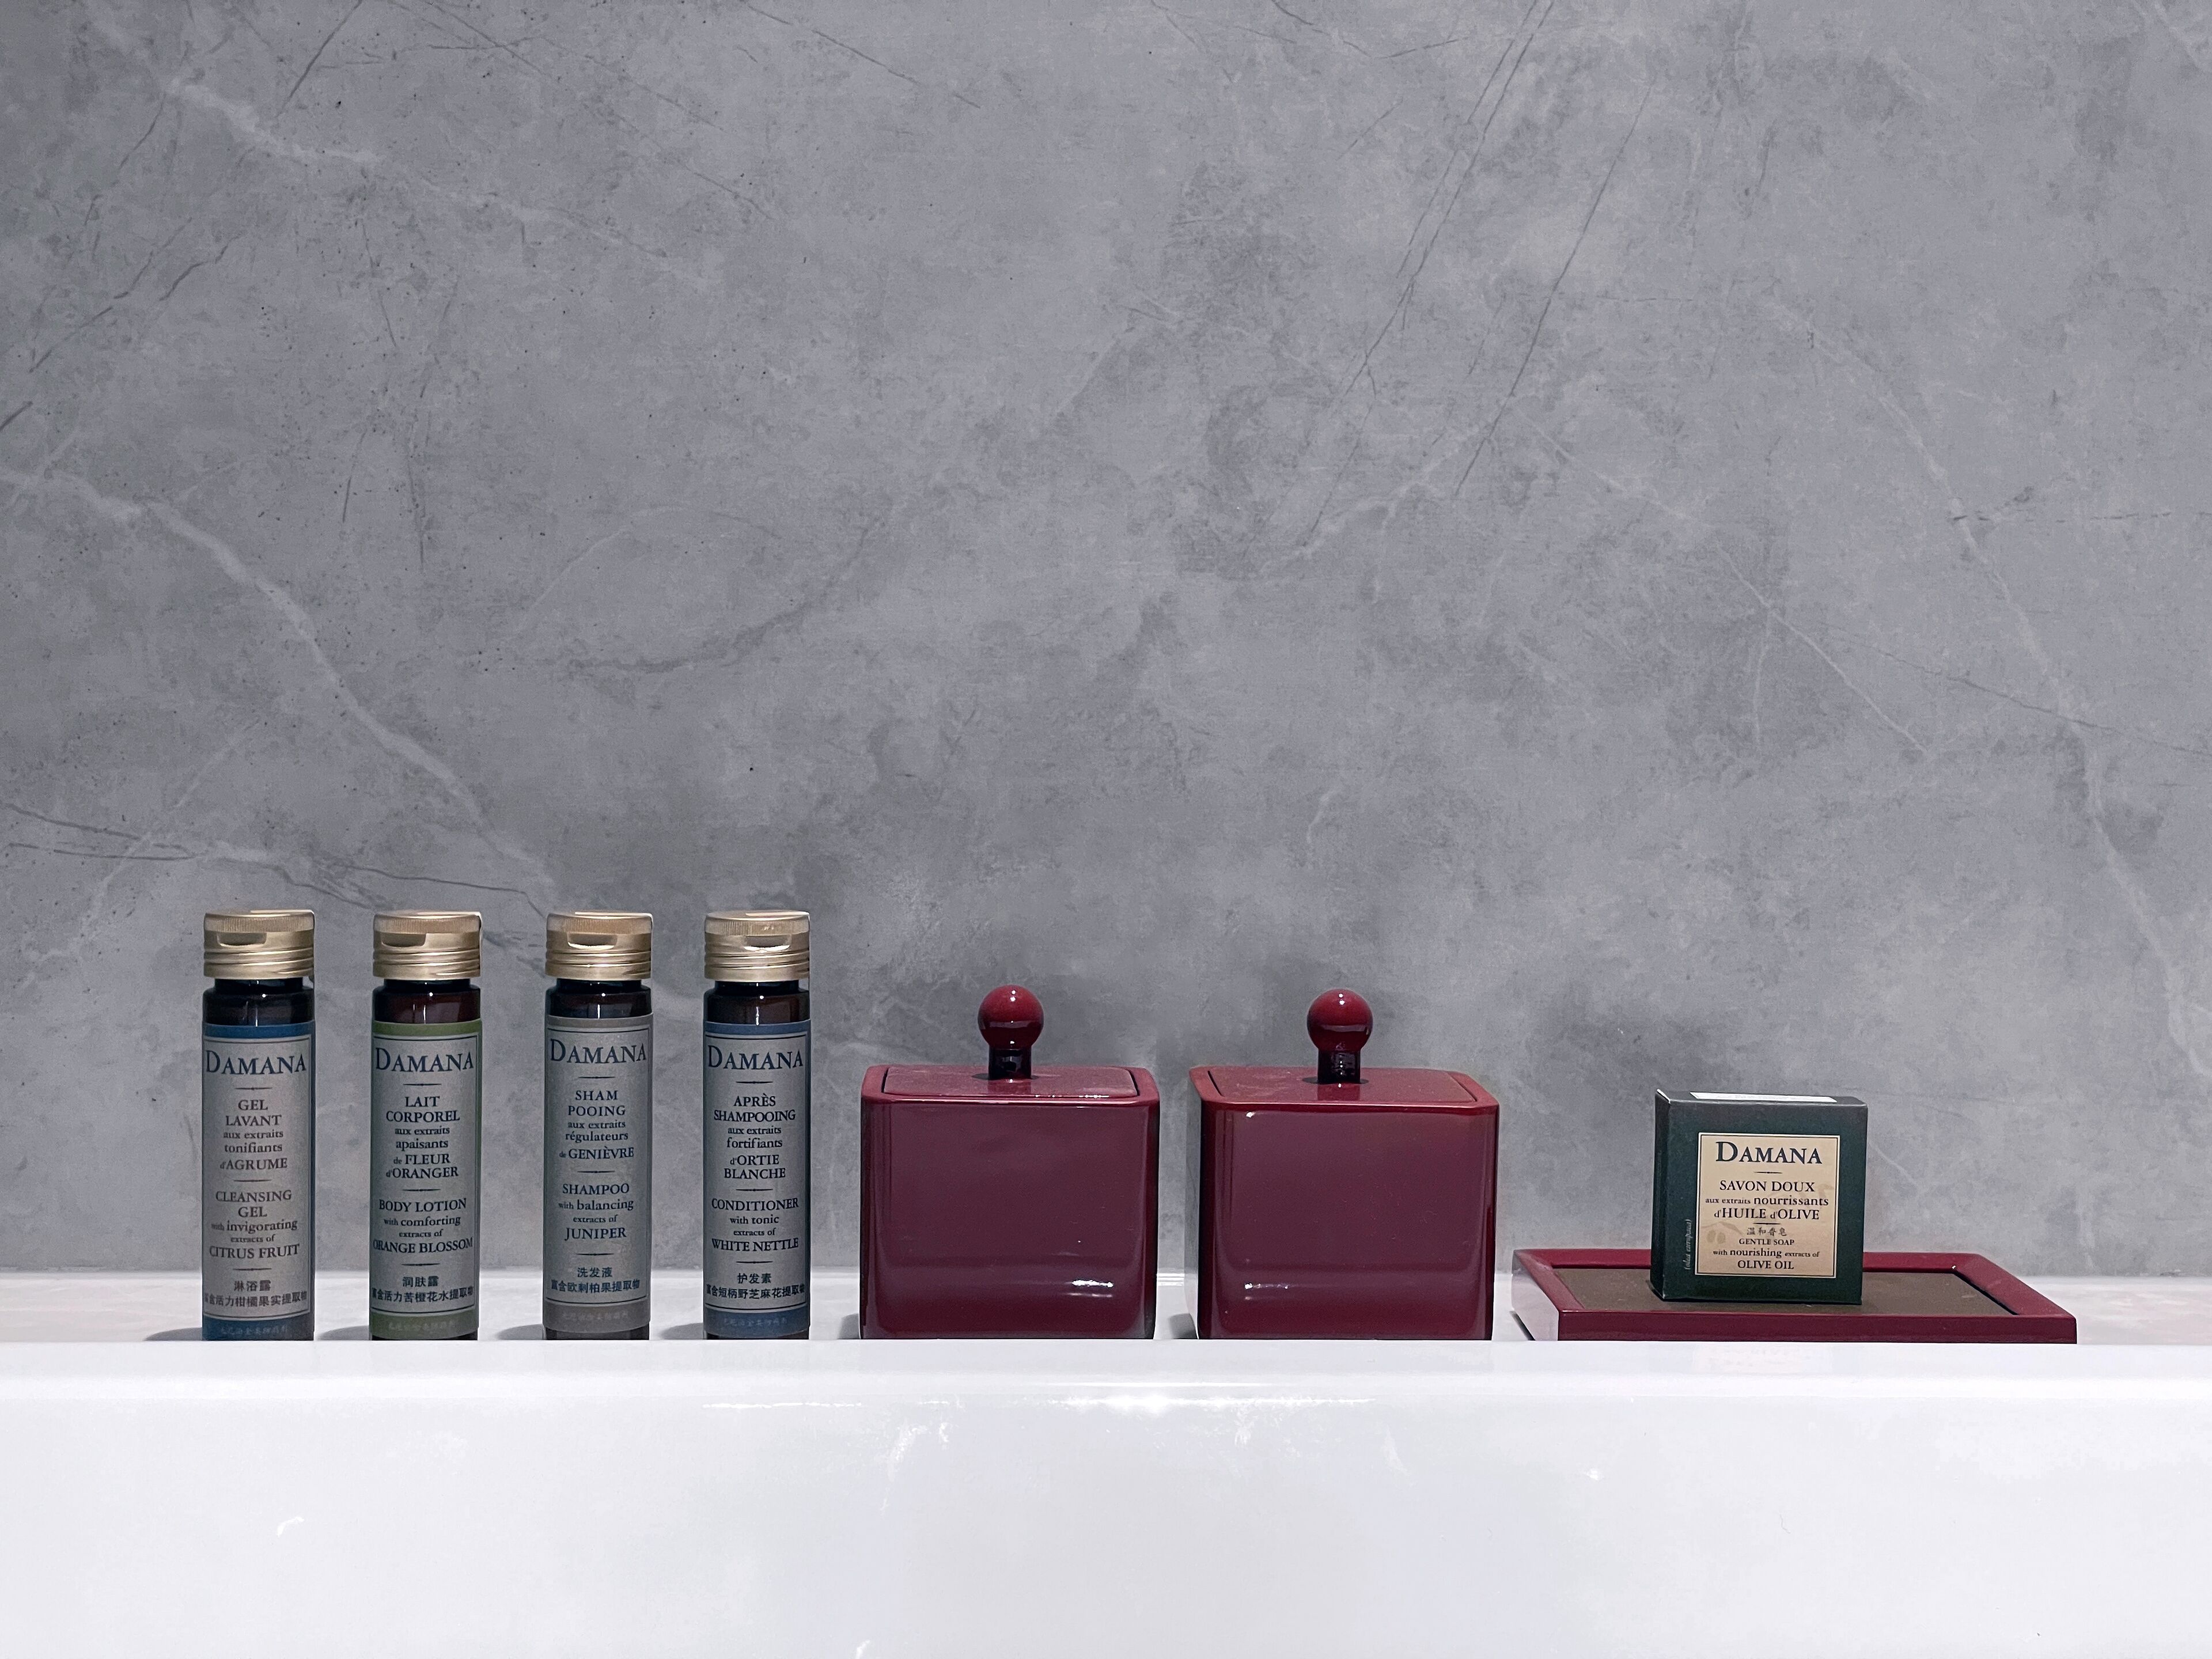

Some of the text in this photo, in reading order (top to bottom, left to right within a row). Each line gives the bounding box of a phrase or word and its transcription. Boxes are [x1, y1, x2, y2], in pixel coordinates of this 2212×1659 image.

[551, 1038, 646, 1064] DAMANA
[206, 1050, 306, 1075] DAMANA
[376, 1047, 474, 1072] DAMANA
[707, 1045, 803, 1070] DAMANA
[575, 1090, 618, 1101] SHAM
[733, 1093, 776, 1107] APRÈS
[238, 1100, 268, 1110] GEL
[405, 1096, 440, 1107] LAIT
[568, 1105, 626, 1116] POOING
[714, 1109, 796, 1123] SHAMPOOING
[225, 1115, 282, 1126] LAVANT
[386, 1110, 460, 1123] CORPOREL
[588, 1120, 626, 1128] extraits
[747, 1125, 781, 1134] extraits
[244, 1130, 283, 1138] extraits
[414, 1126, 450, 1135] extraits
[565, 1131, 628, 1143] régulateurs
[726, 1137, 783, 1148] fortifiants
[225, 1142, 282, 1152] tonifiants
[396, 1138, 448, 1151] apaisants
[569, 1146, 634, 1159] GENIÈVRE
[1715, 1141, 1822, 1164] DAMANA
[406, 1154, 450, 1165] FLEUR
[386, 1166, 459, 1179] d'ORANGER
[724, 1168, 786, 1179] BLANCHE
[563, 1183, 630, 1195] SHAMPOO
[1719, 1180, 1815, 1192] SAVON DOUX
[215, 1190, 292, 1202] CLEANSING
[1753, 1195, 1828, 1206] nourrissants
[379, 1198, 467, 1212] BODY LOTION
[577, 1199, 634, 1211] balancing
[712, 1198, 799, 1211] CONDITIONER
[238, 1207, 267, 1217] GEL
[1714, 1207, 1819, 1219] d'HUILE d'OLIVE
[401, 1216, 461, 1226] comforting
[609, 1214, 619, 1222] of
[752, 1214, 779, 1224] tonic
[211, 1219, 297, 1233] with invigorating
[434, 1229, 444, 1237] of
[565, 1227, 627, 1241] JUNIPER
[767, 1228, 776, 1236] of
[266, 1234, 276, 1242] of
[373, 1237, 473, 1253] ORANGE BLOSSOM
[712, 1237, 798, 1252] WHITE NETTLE
[210, 1244, 300, 1259] CITRUS FRUIT
[1729, 1248, 1782, 1258] nourishing
[1737, 1260, 1794, 1270] OLIVE OIL
[577, 1267, 612, 1278] 洗发液
[403, 1275, 439, 1287] 润肤露
[737, 1273, 772, 1284] 护发素
[234, 1280, 271, 1291] 淋浴露
